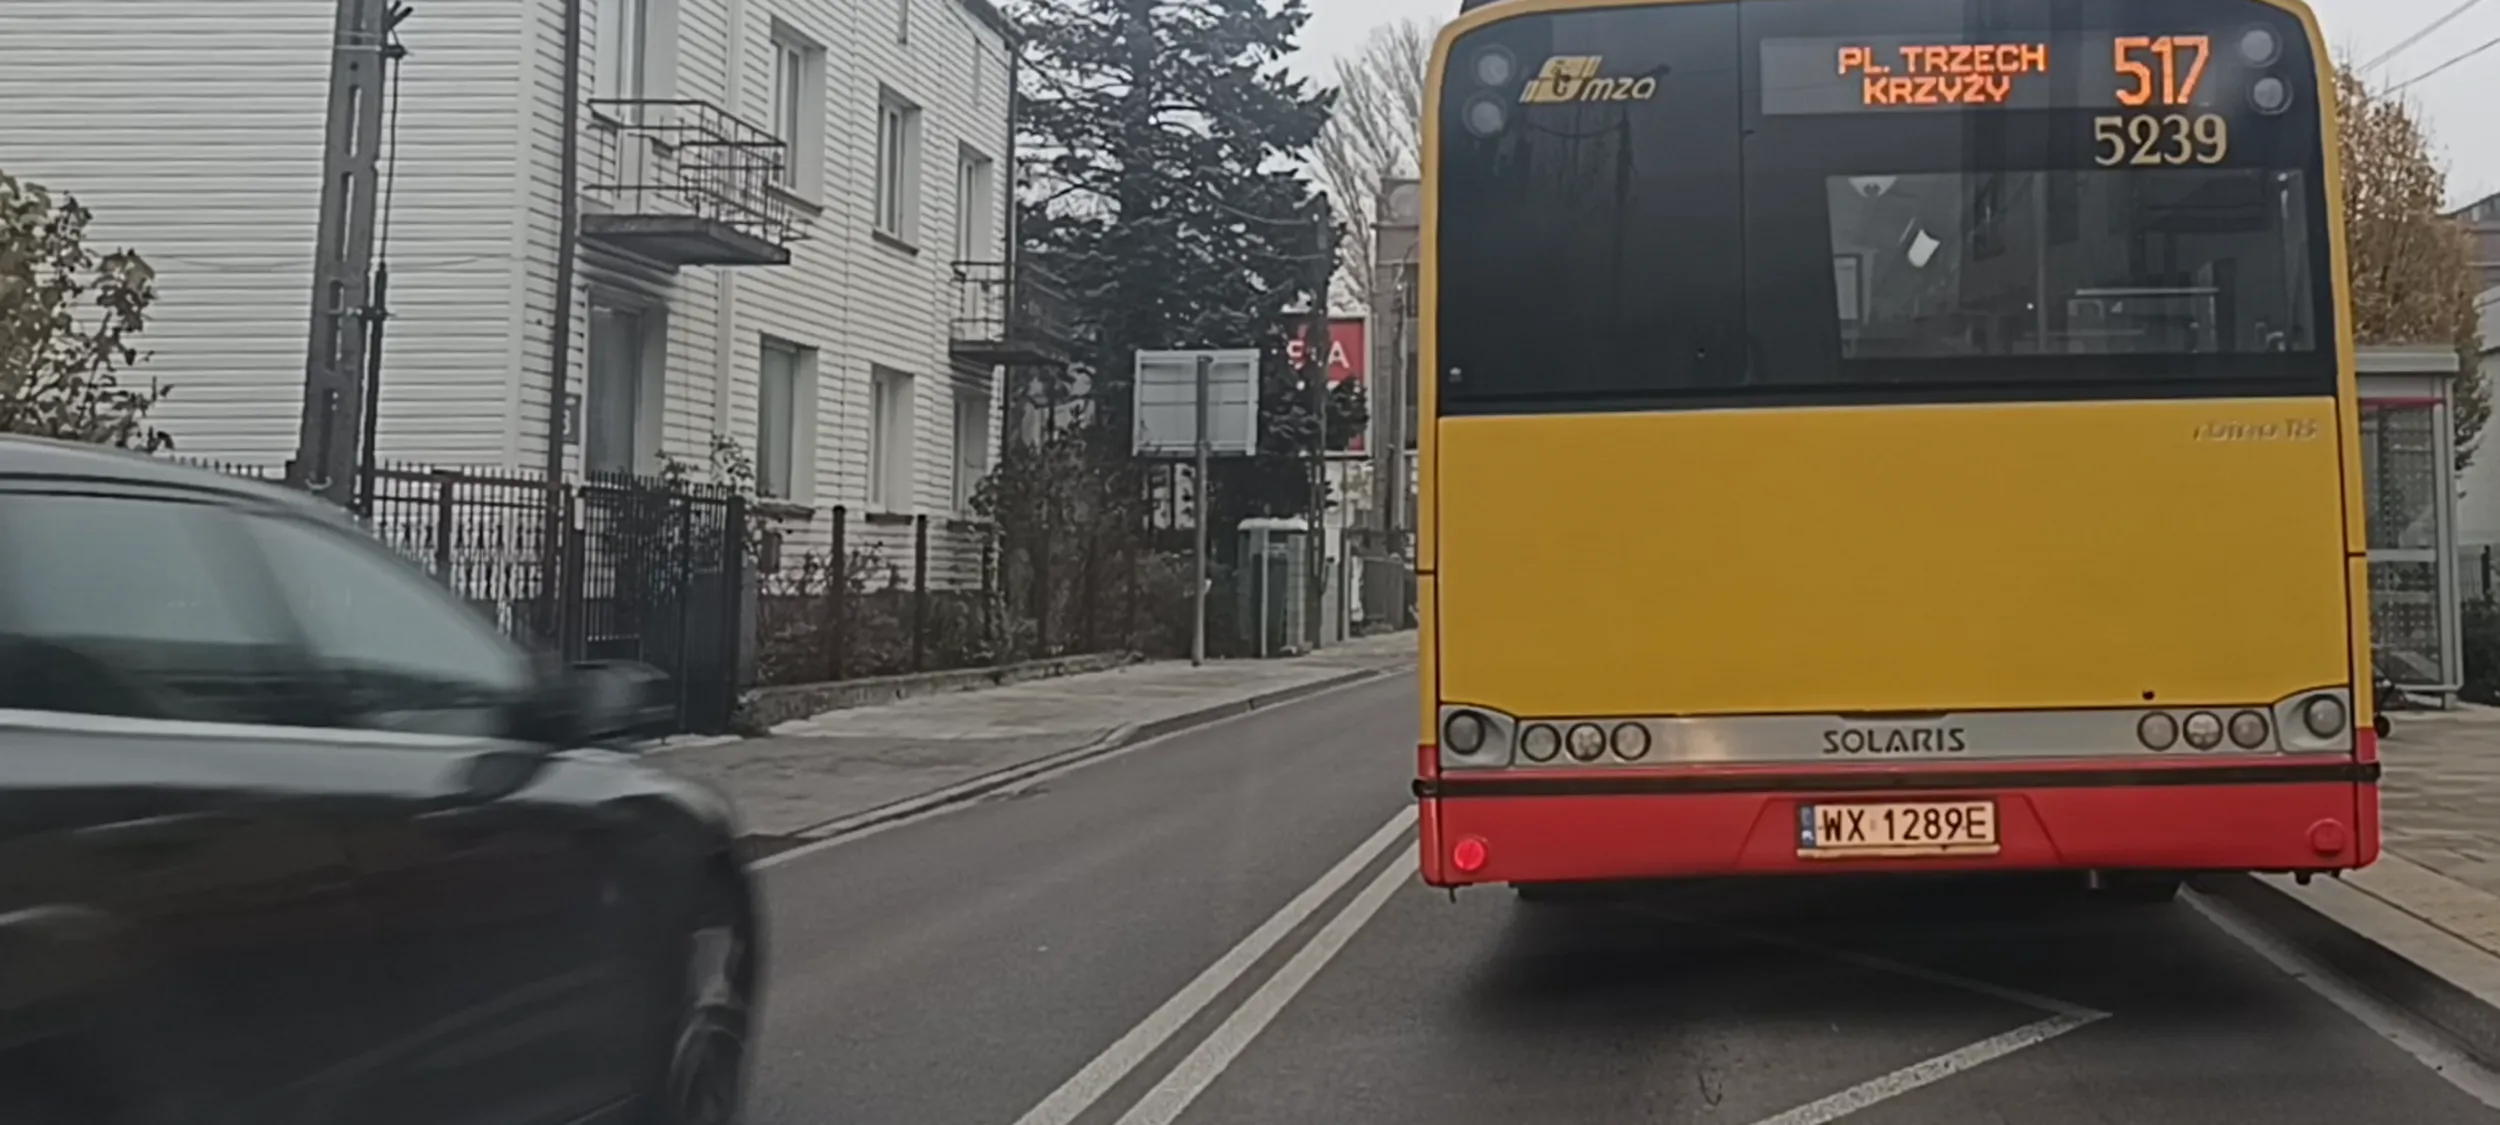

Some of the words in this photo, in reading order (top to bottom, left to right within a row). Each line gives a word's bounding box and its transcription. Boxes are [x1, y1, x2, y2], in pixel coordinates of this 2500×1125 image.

[1837, 46, 1890, 75] PL.
[1899, 44, 2046, 74] TRZECH
[2114, 35, 2209, 105] 517
[1580, 77, 1656, 101] mza
[2094, 113, 2227, 165] 5239
[1823, 729, 1966, 754] SOLARIS
[1822, 809, 1866, 842] WX
[1883, 806, 1987, 841] 1289E
